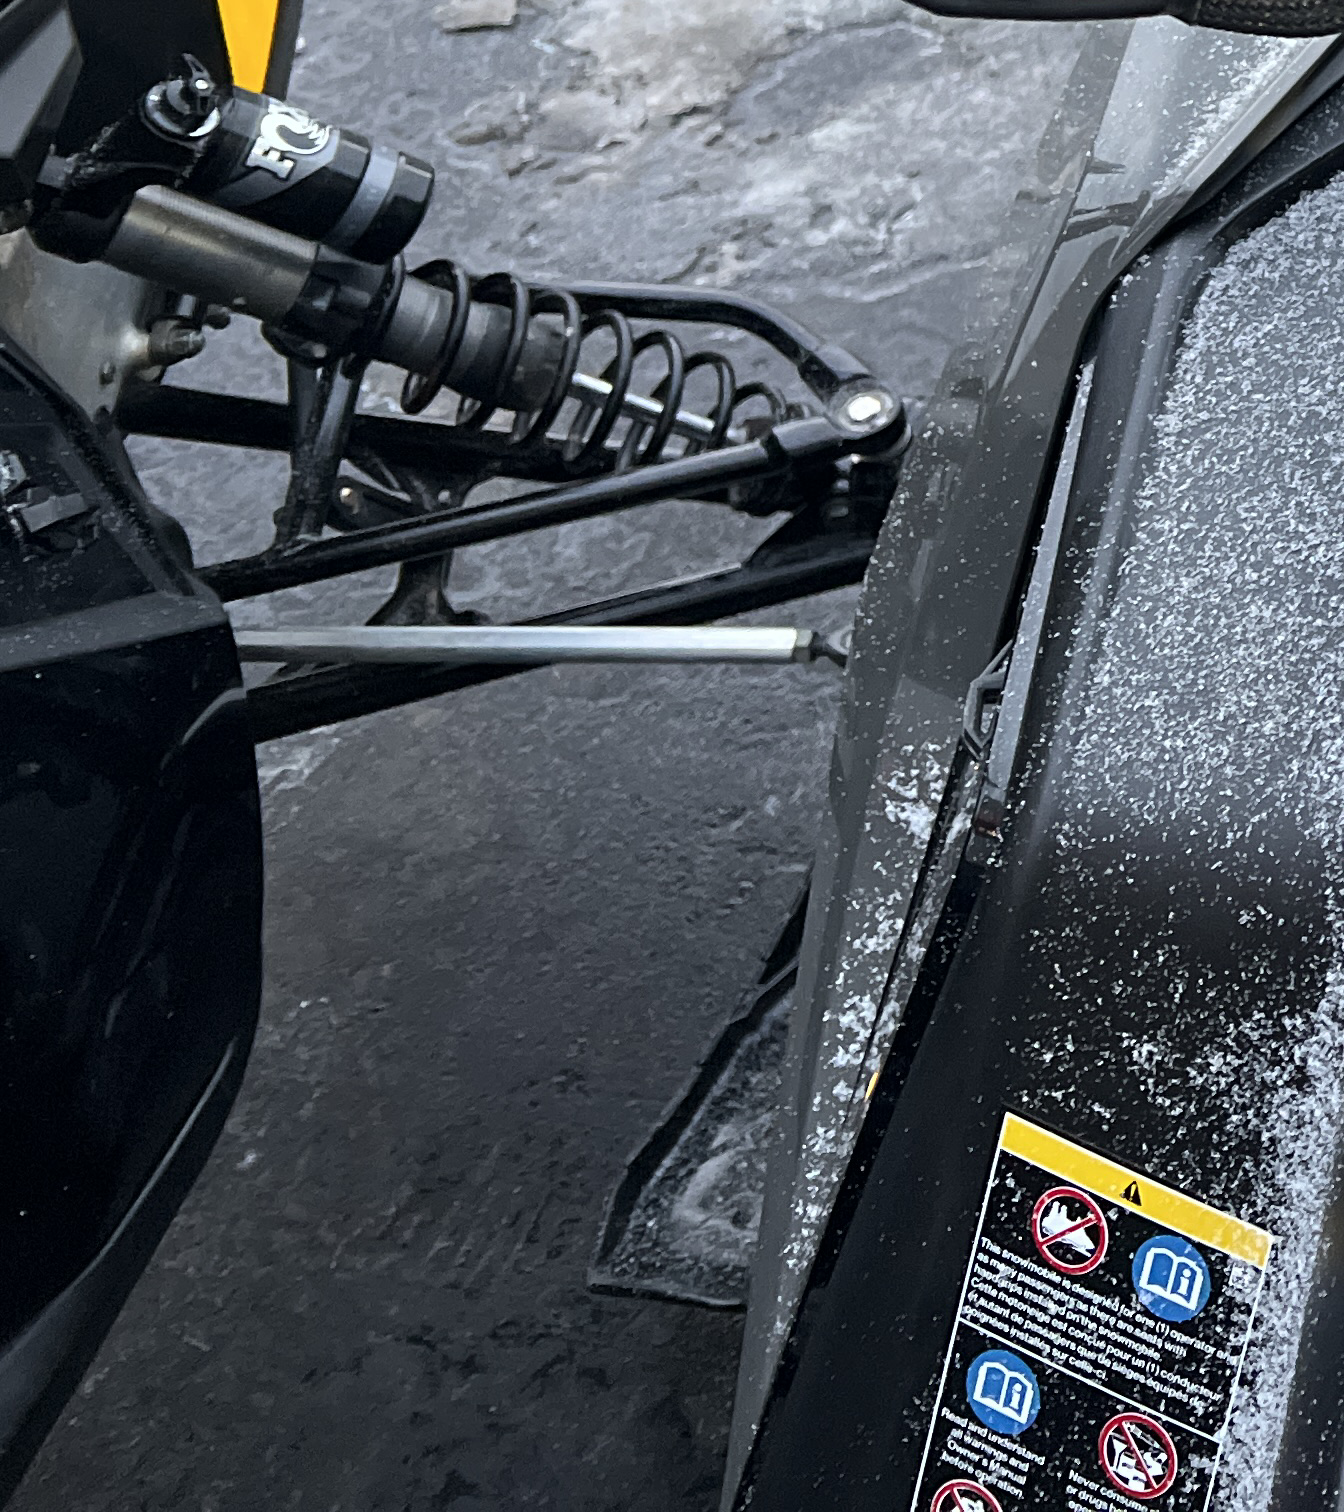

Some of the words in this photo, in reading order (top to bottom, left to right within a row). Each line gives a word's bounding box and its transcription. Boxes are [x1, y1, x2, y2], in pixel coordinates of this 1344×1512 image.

[1001, 1246, 1062, 1284] snowmobile
[1154, 1320, 1170, 1337] (1)
[1168, 1326, 1216, 1358] operator
[970, 1275, 998, 1297] Cette
[996, 1290, 1051, 1325] motoneige
[1105, 1343, 1131, 1365] pour
[1130, 1355, 1145, 1370] un
[1144, 1360, 1160, 1377] (1)
[1163, 1339, 1187, 1358] with
[940, 1406, 968, 1428] Read
[967, 1420, 988, 1438] and
[987, 1429, 1045, 1466] understand
[941, 1450, 975, 1474] before
[1008, 1454, 1029, 1472] and
[1067, 1469, 1100, 1493] Never
[1099, 1485, 1148, 1512] consume
[1076, 1487, 1109, 1512] drugs
